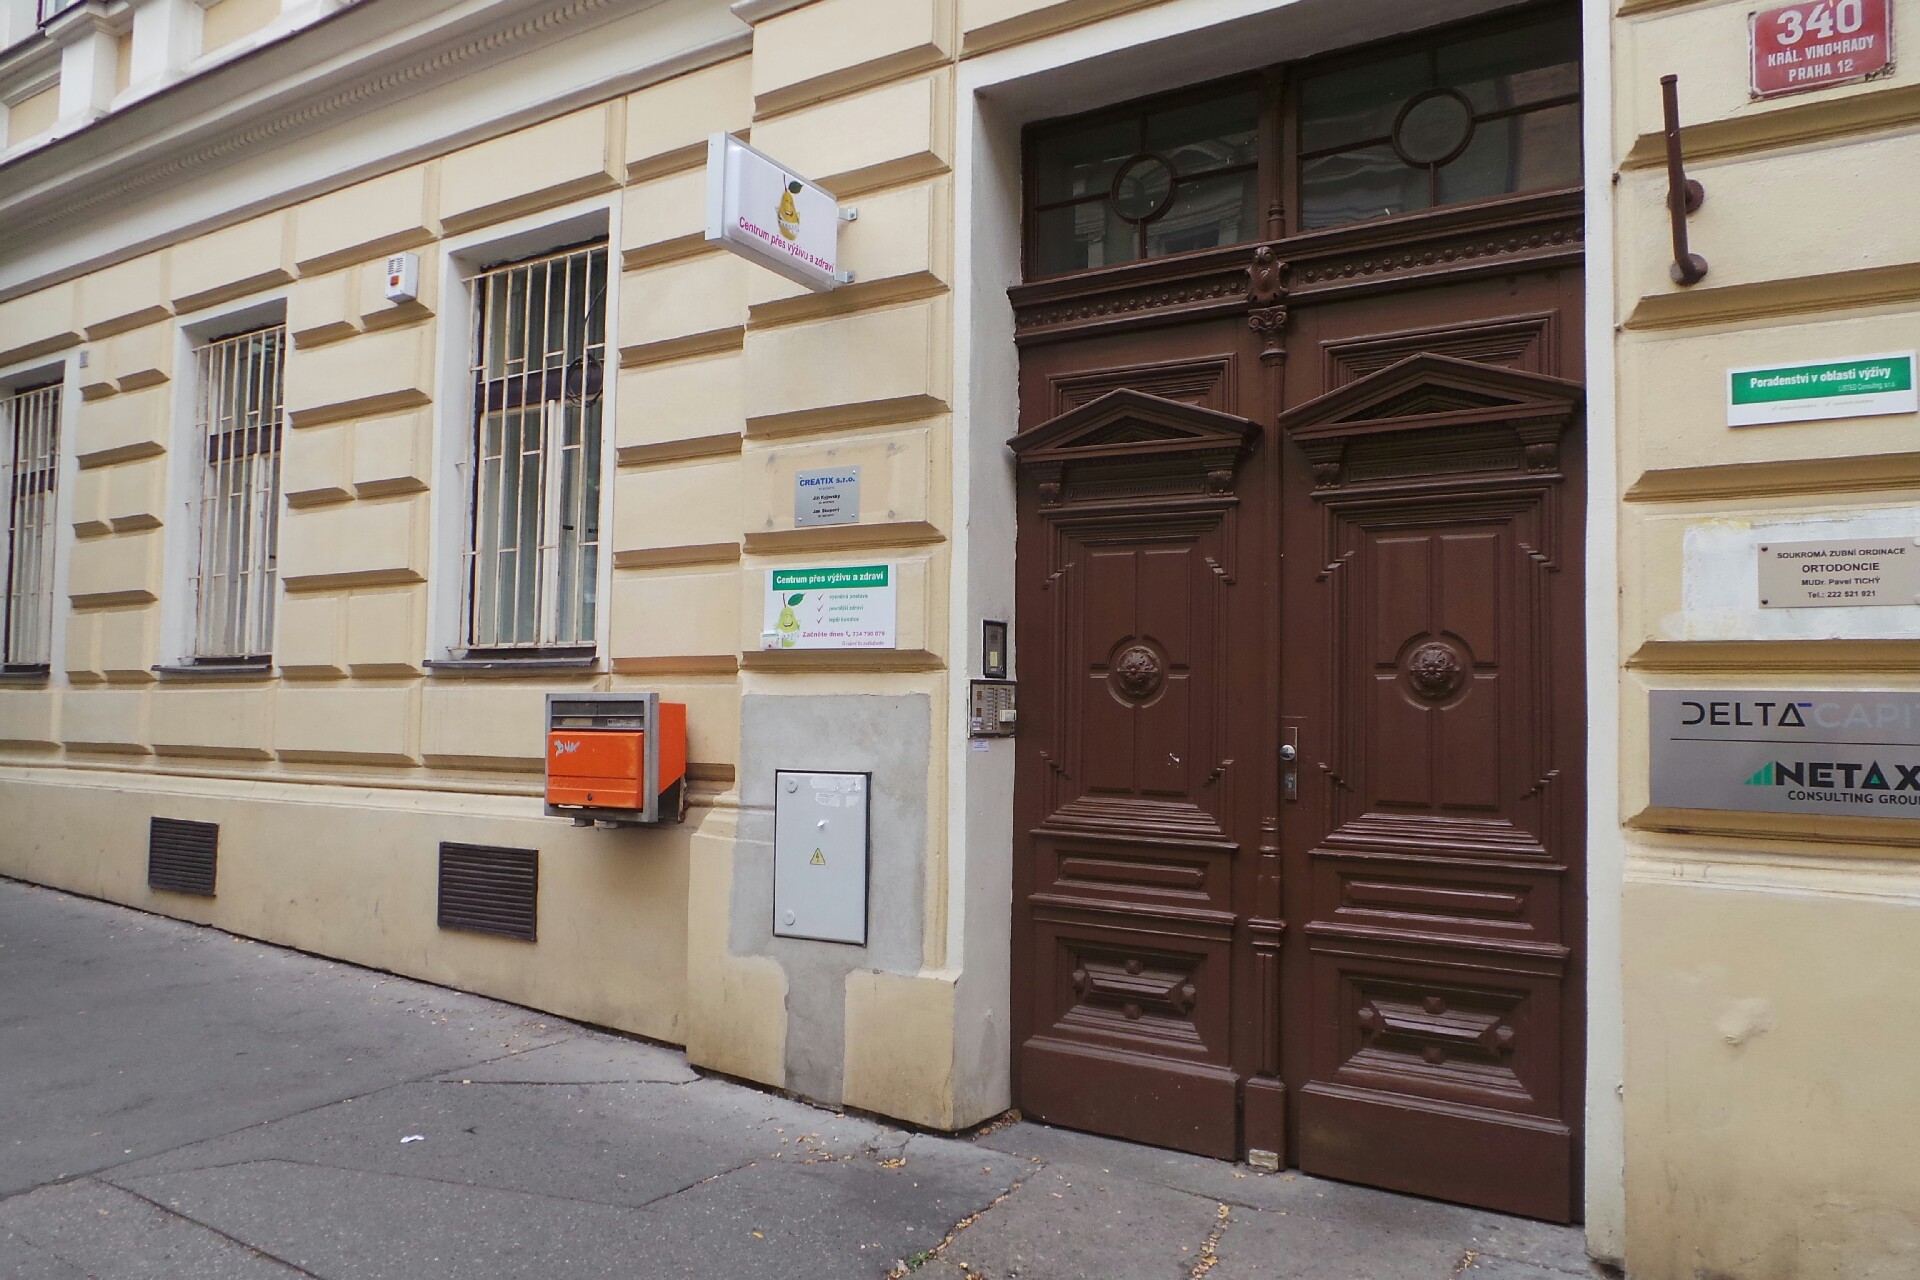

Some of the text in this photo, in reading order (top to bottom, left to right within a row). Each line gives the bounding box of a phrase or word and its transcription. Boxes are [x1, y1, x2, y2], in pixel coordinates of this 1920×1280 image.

[1776, 0, 1862, 46] 340
[1768, 35, 1875, 67] KRÁL. VINOHRADY
[1789, 58, 1854, 82] PRAHA 12
[739, 216, 835, 273] Centrum přes výživu a zdraví
[1750, 366, 1891, 389] Poradenství v oblasti výživy
[800, 477, 833, 486] CREATIX
[1777, 547, 1906, 559] SOUKROMÁ ZUBNÍ ORDINACE
[776, 575, 807, 584] Centrum
[809, 574, 825, 584] přes
[827, 573, 851, 583] výživu
[860, 571, 884, 581] zdraví
[1802, 562, 1880, 573] ORTODONCIE
[1682, 701, 1920, 729] DELTA CAPI
[1775, 760, 1920, 791] NETAX
[1788, 790, 1920, 806] CONSULTING GROU
